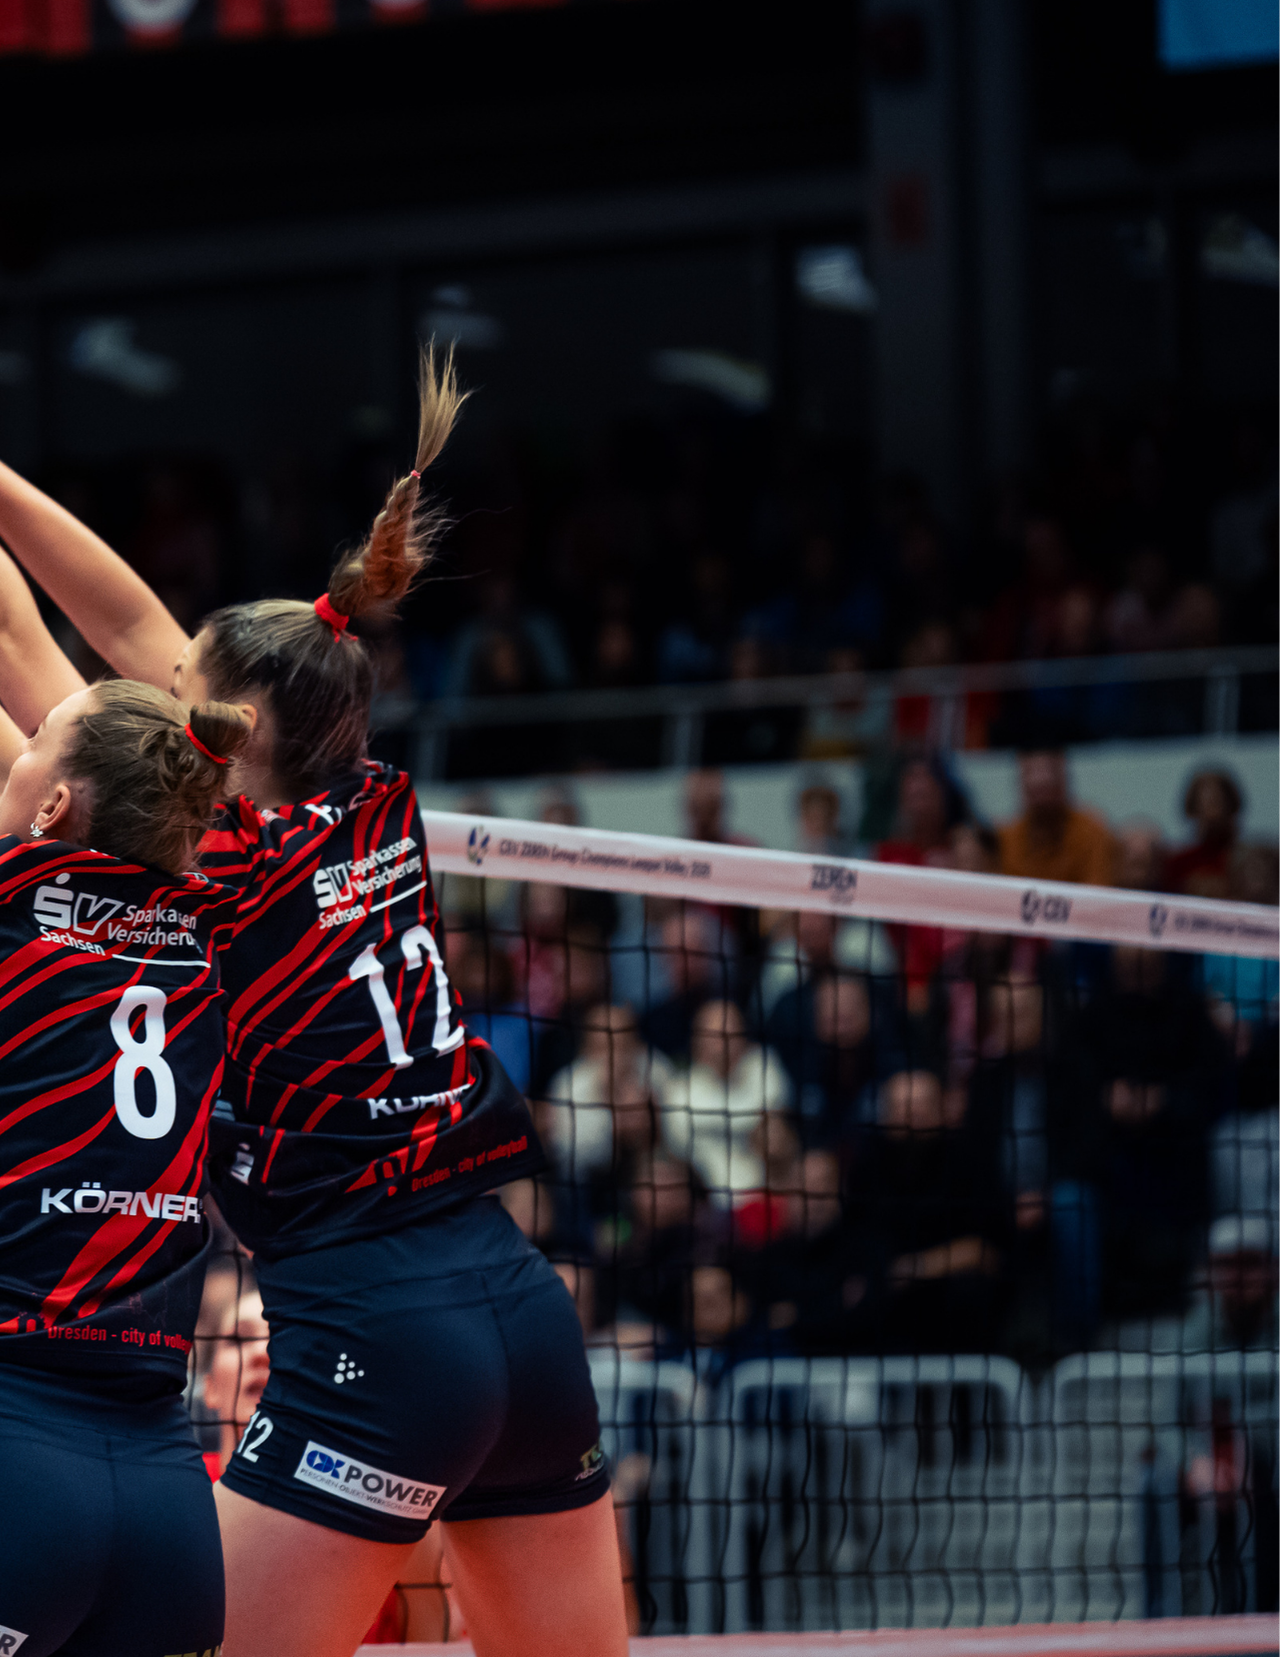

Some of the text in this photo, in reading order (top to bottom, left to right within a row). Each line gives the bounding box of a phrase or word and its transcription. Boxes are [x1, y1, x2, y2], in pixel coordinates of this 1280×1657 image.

[347, 837, 418, 876] Sparkassen
[351, 855, 423, 895] Versicherung
[319, 904, 367, 929] Sachsen
[39, 925, 106, 956] Sachsen
[349, 924, 465, 1071] 12
[110, 985, 176, 1139] 8
[412, 1167, 451, 1192] Dresden
[458, 1157, 474, 1173] city
[476, 1151, 486, 1166] of
[487, 1135, 528, 1161] volleyball
[41, 1181, 200, 1224] KÖRNER
[47, 1324, 107, 1341] Dresden
[121, 1327, 146, 1347] city
[149, 1330, 161, 1346] of
[344, 1464, 439, 1508] POWER
